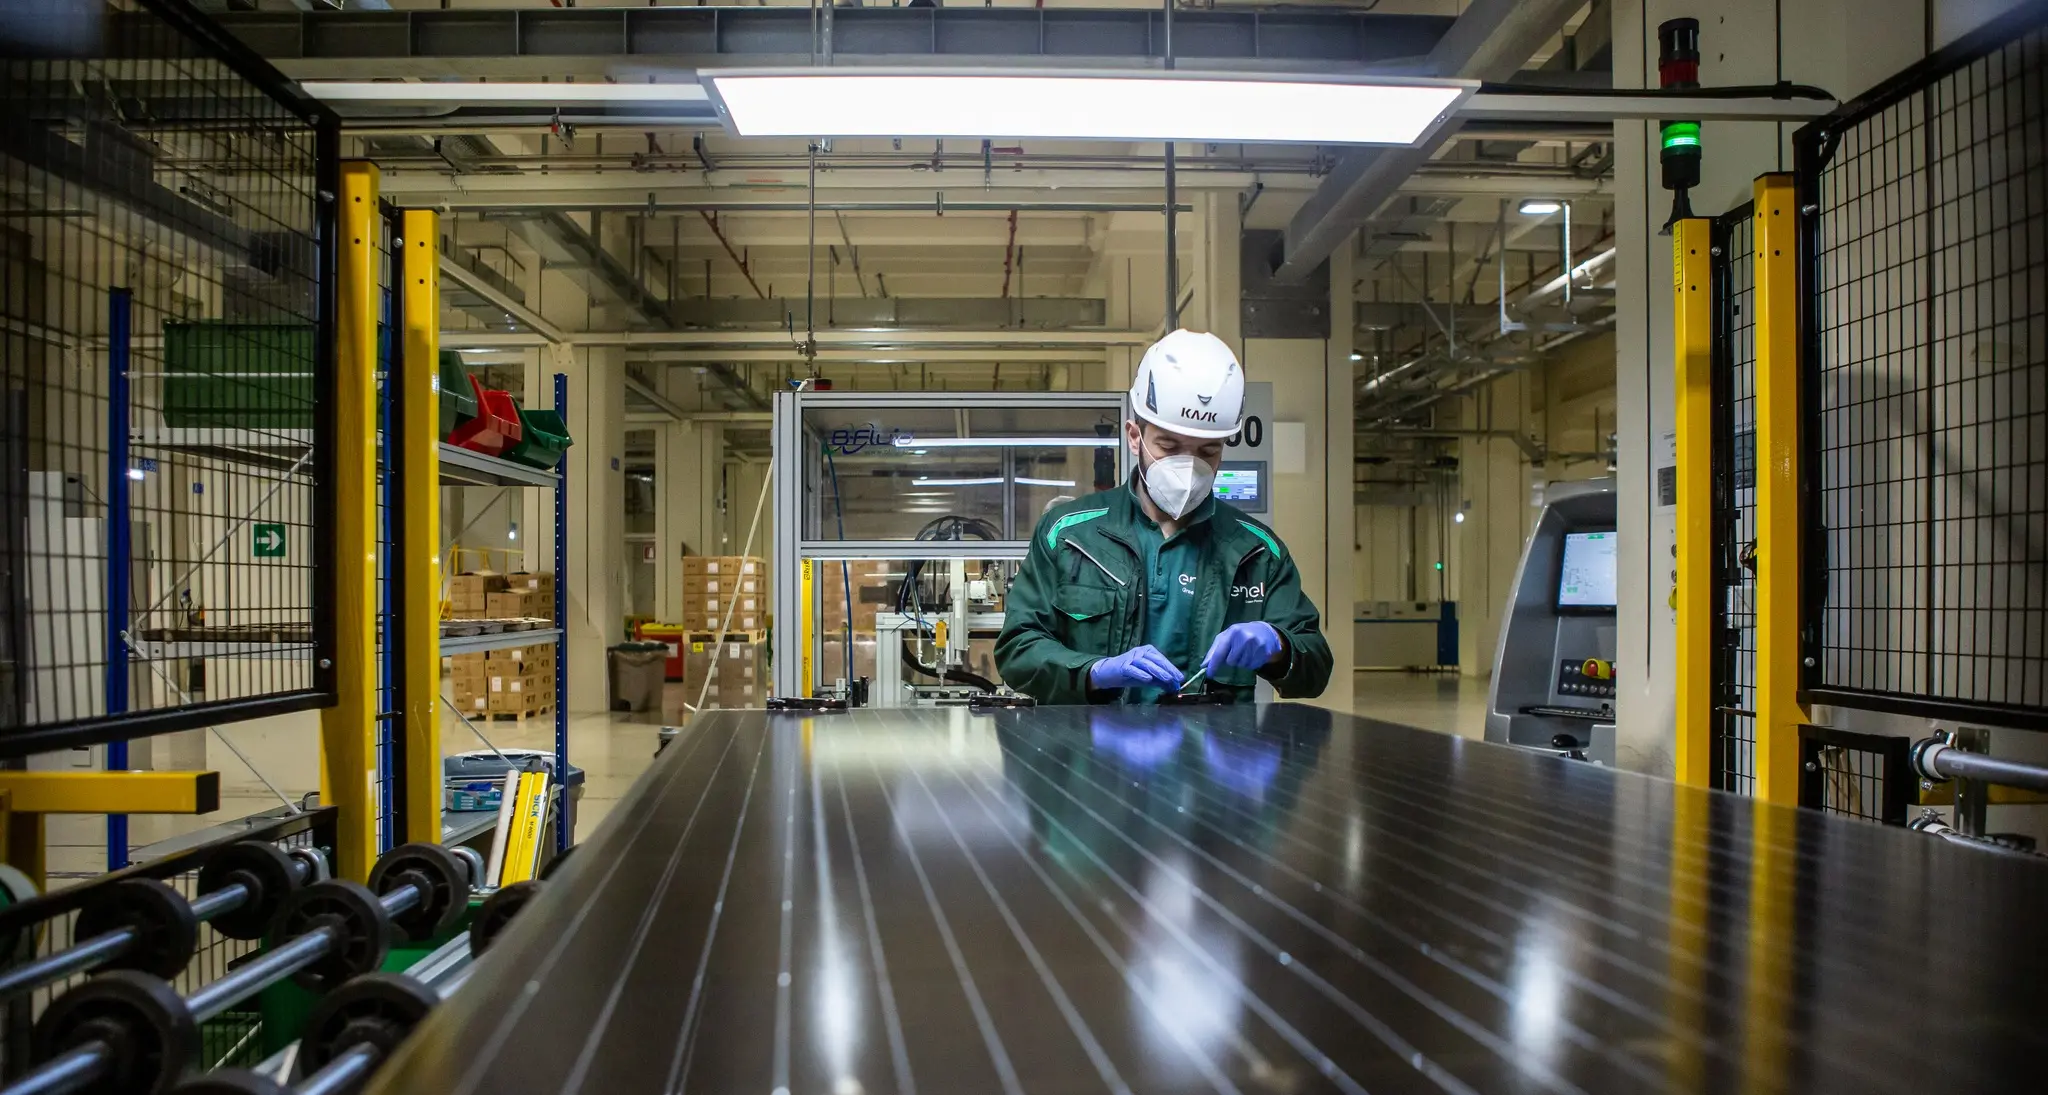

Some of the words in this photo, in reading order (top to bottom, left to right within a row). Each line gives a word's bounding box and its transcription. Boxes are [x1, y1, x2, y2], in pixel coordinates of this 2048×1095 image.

[1181, 407, 1218, 423] KASK
[1230, 581, 1265, 598] enel
[531, 794, 541, 818] SICK
